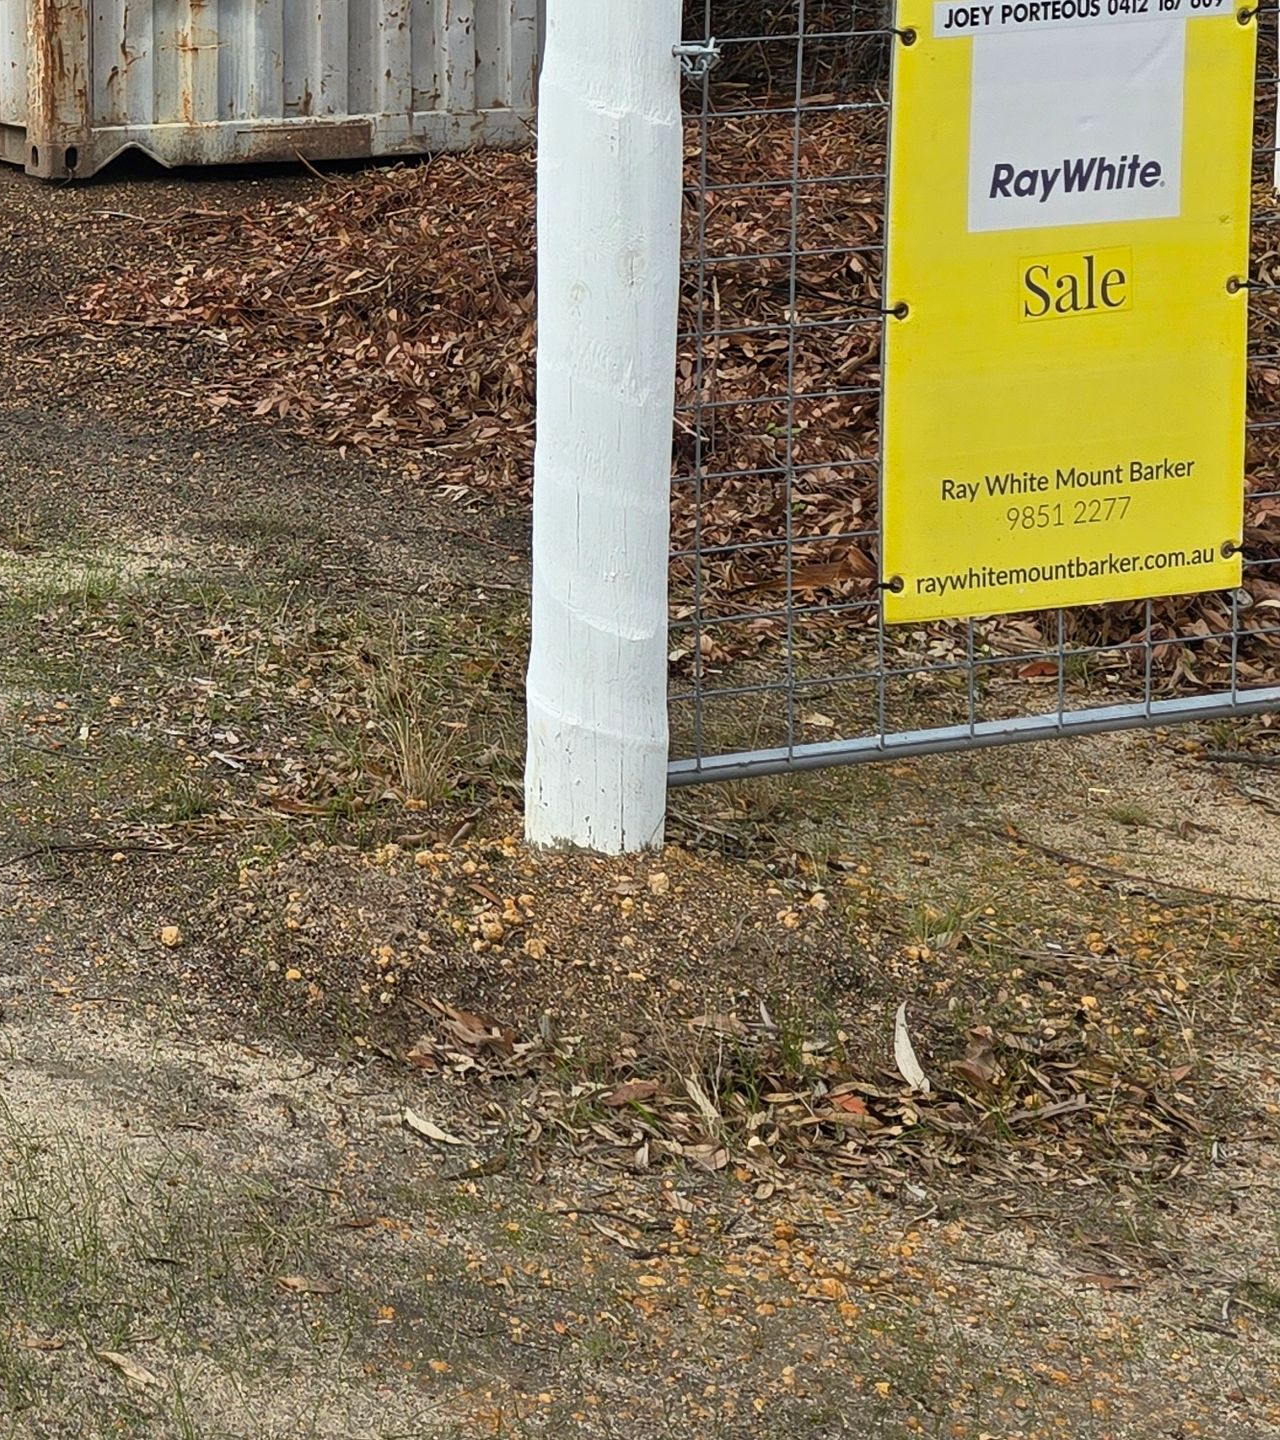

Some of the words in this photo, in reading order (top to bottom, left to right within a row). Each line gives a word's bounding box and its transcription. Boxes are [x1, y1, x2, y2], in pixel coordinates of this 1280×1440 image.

[944, 6, 994, 28] JOEY
[1024, 255, 1126, 318] Sale
[941, 479, 980, 503] Ray
[985, 472, 1049, 497] White
[1055, 464, 1123, 490] Mount
[1129, 458, 1195, 484] Barker
[1006, 503, 1065, 531] 9851
[1073, 496, 1132, 524] 2277
[916, 546, 1215, 597] raywhitemountbarker.com.au
